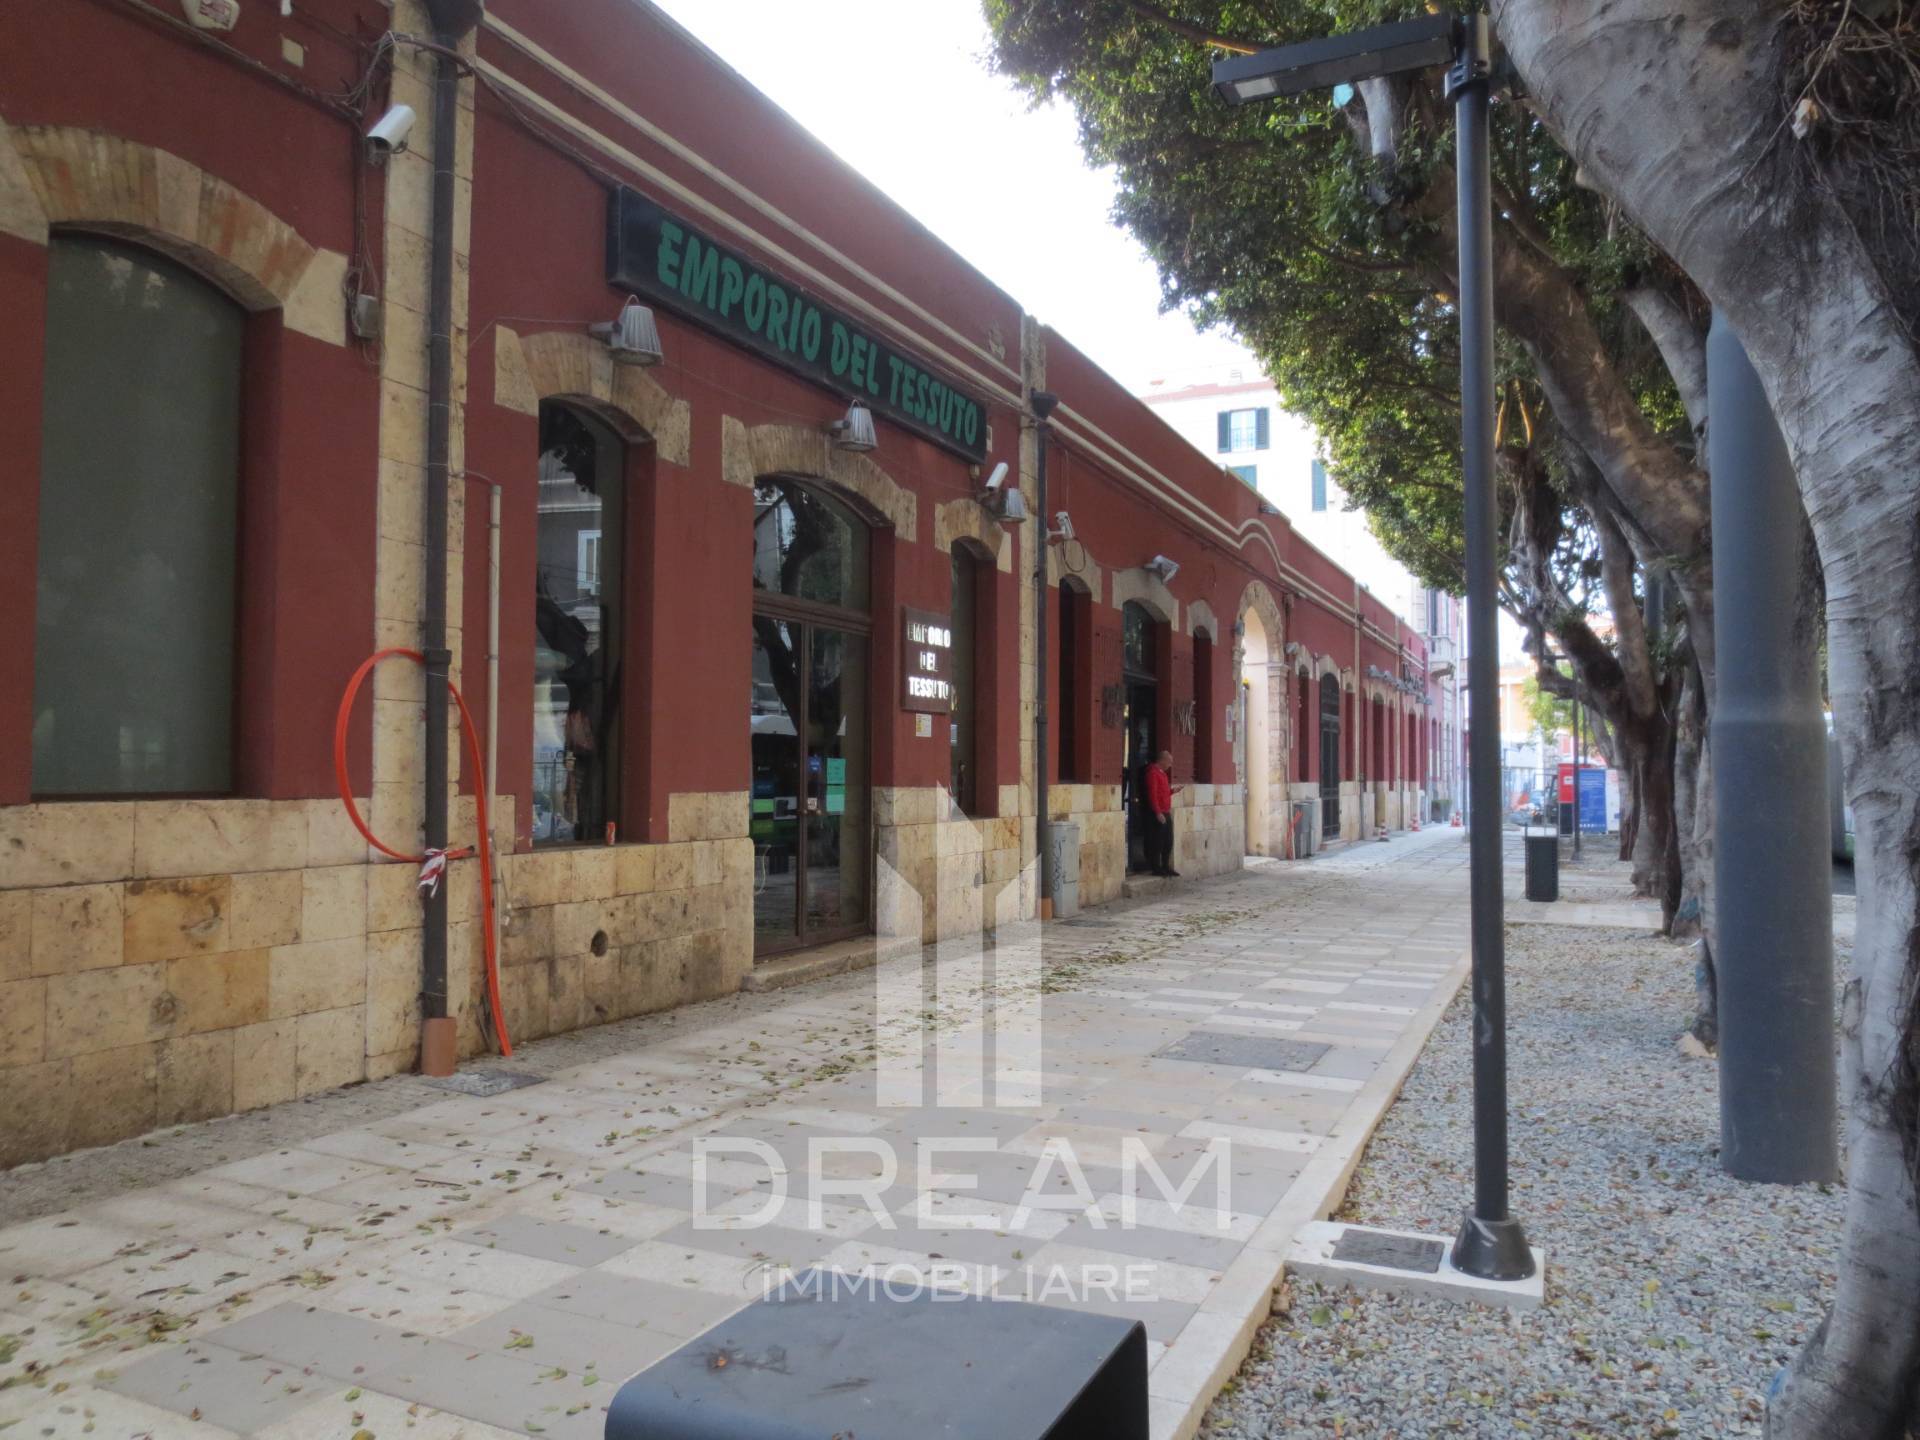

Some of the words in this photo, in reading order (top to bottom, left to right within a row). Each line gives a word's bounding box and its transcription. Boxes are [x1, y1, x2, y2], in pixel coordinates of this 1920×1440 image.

[656, 222, 822, 361] EMPORIO
[831, 323, 880, 393] DEL
[889, 356, 977, 445] TESSUTO
[909, 677, 950, 700] TESSUTO
